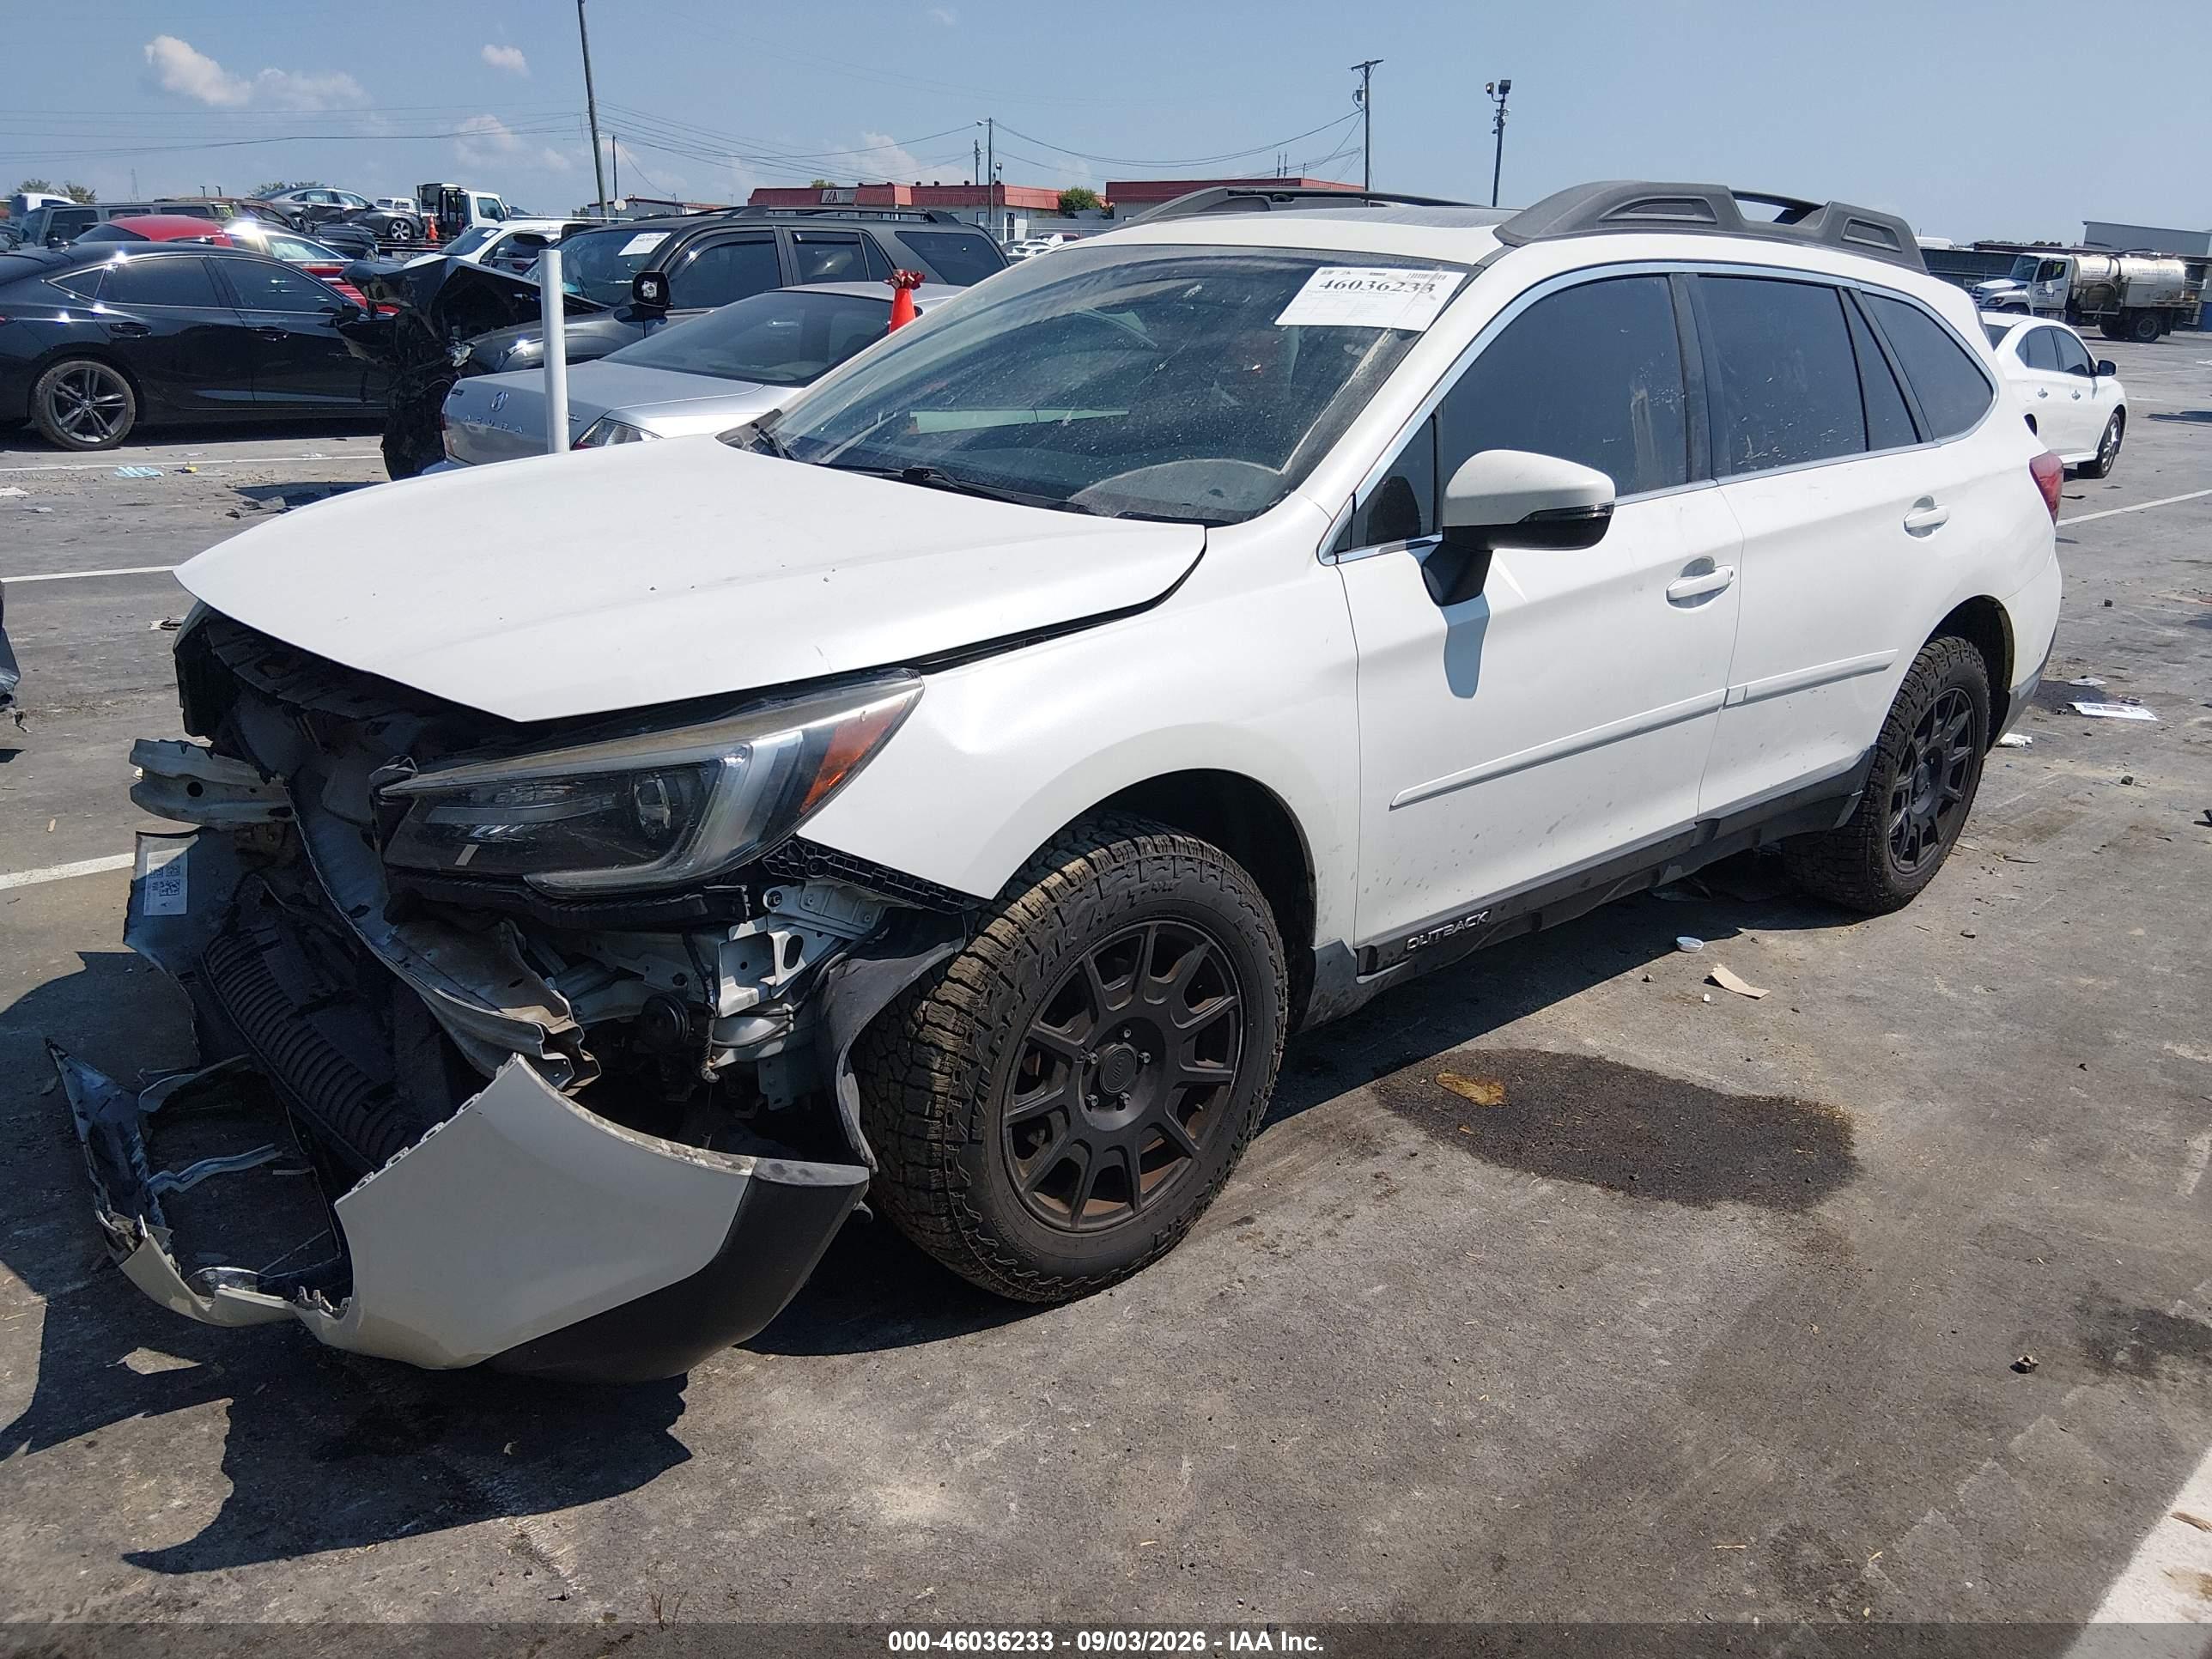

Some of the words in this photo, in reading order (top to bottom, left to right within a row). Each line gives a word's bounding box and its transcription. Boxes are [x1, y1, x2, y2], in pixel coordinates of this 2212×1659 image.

[1319, 278, 1437, 295] 46036233
[465, 414, 524, 434] ACURA
[1406, 910, 1491, 951] OUTBACK
